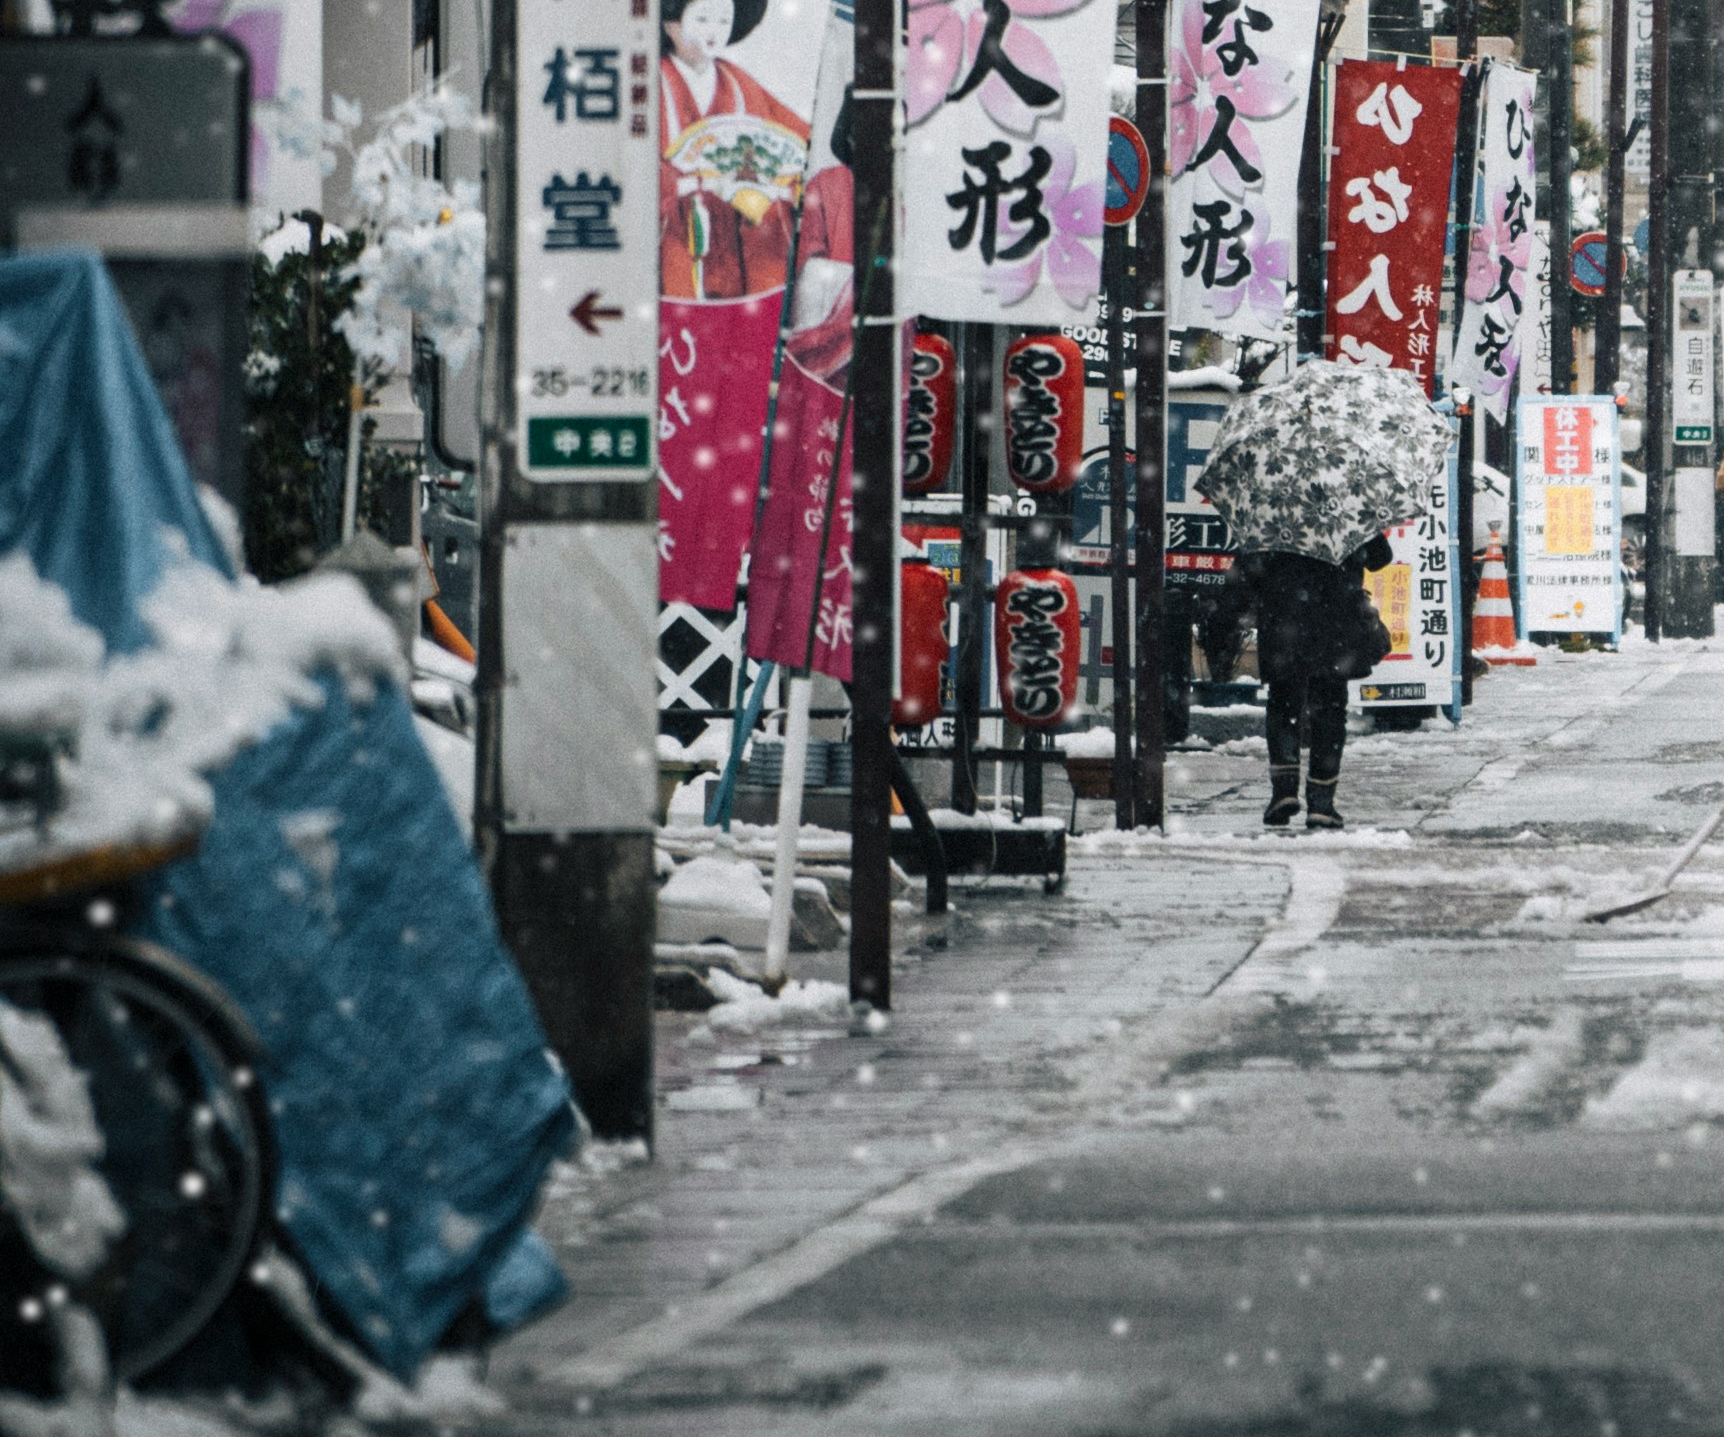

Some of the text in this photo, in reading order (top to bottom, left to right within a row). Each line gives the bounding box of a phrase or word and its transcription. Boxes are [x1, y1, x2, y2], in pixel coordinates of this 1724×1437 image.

[1687, 336, 1703, 395] 自遊石
[1008, 348, 1066, 484] やきとり
[1555, 407, 1580, 473] 休工中
[1007, 585, 1067, 718] やきとり
